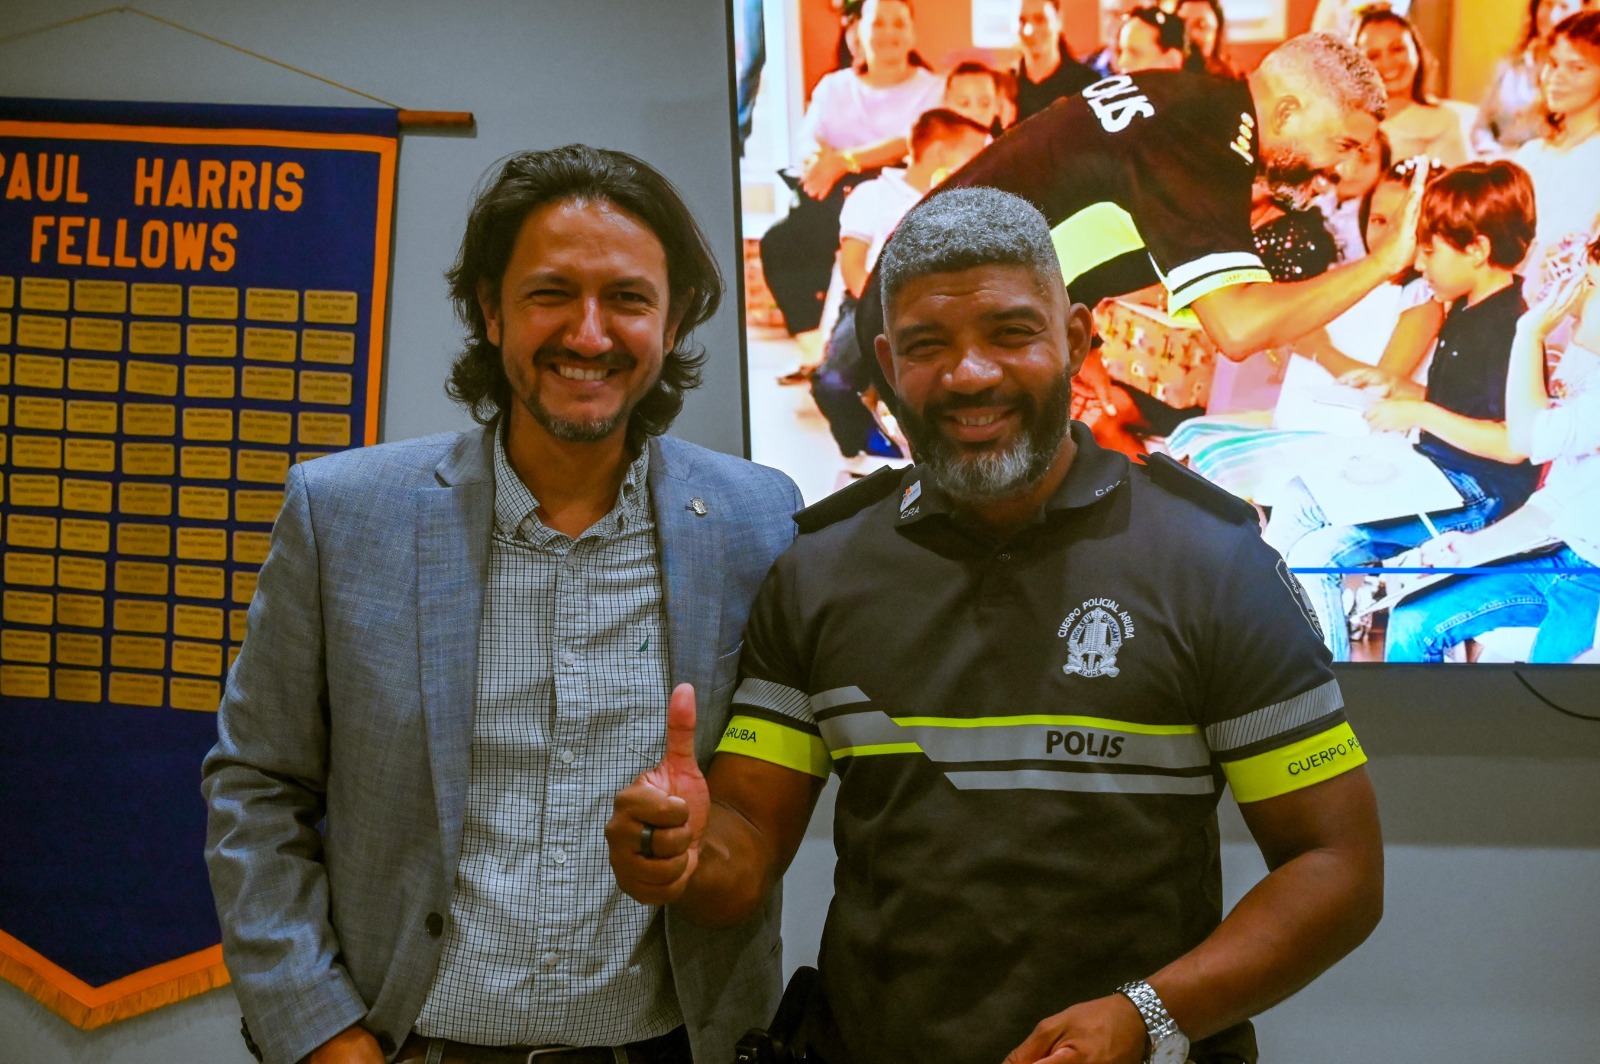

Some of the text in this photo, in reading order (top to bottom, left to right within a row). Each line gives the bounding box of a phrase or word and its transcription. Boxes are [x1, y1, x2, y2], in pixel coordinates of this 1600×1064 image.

[0, 152, 305, 212] AUL HARRIS
[31, 215, 238, 272] FELLOWS
[1058, 598, 1135, 639] CUERPO POLICIAL ARUBA
[1046, 730, 1125, 758] POLIS
[1287, 743, 1347, 776] CUERPO
